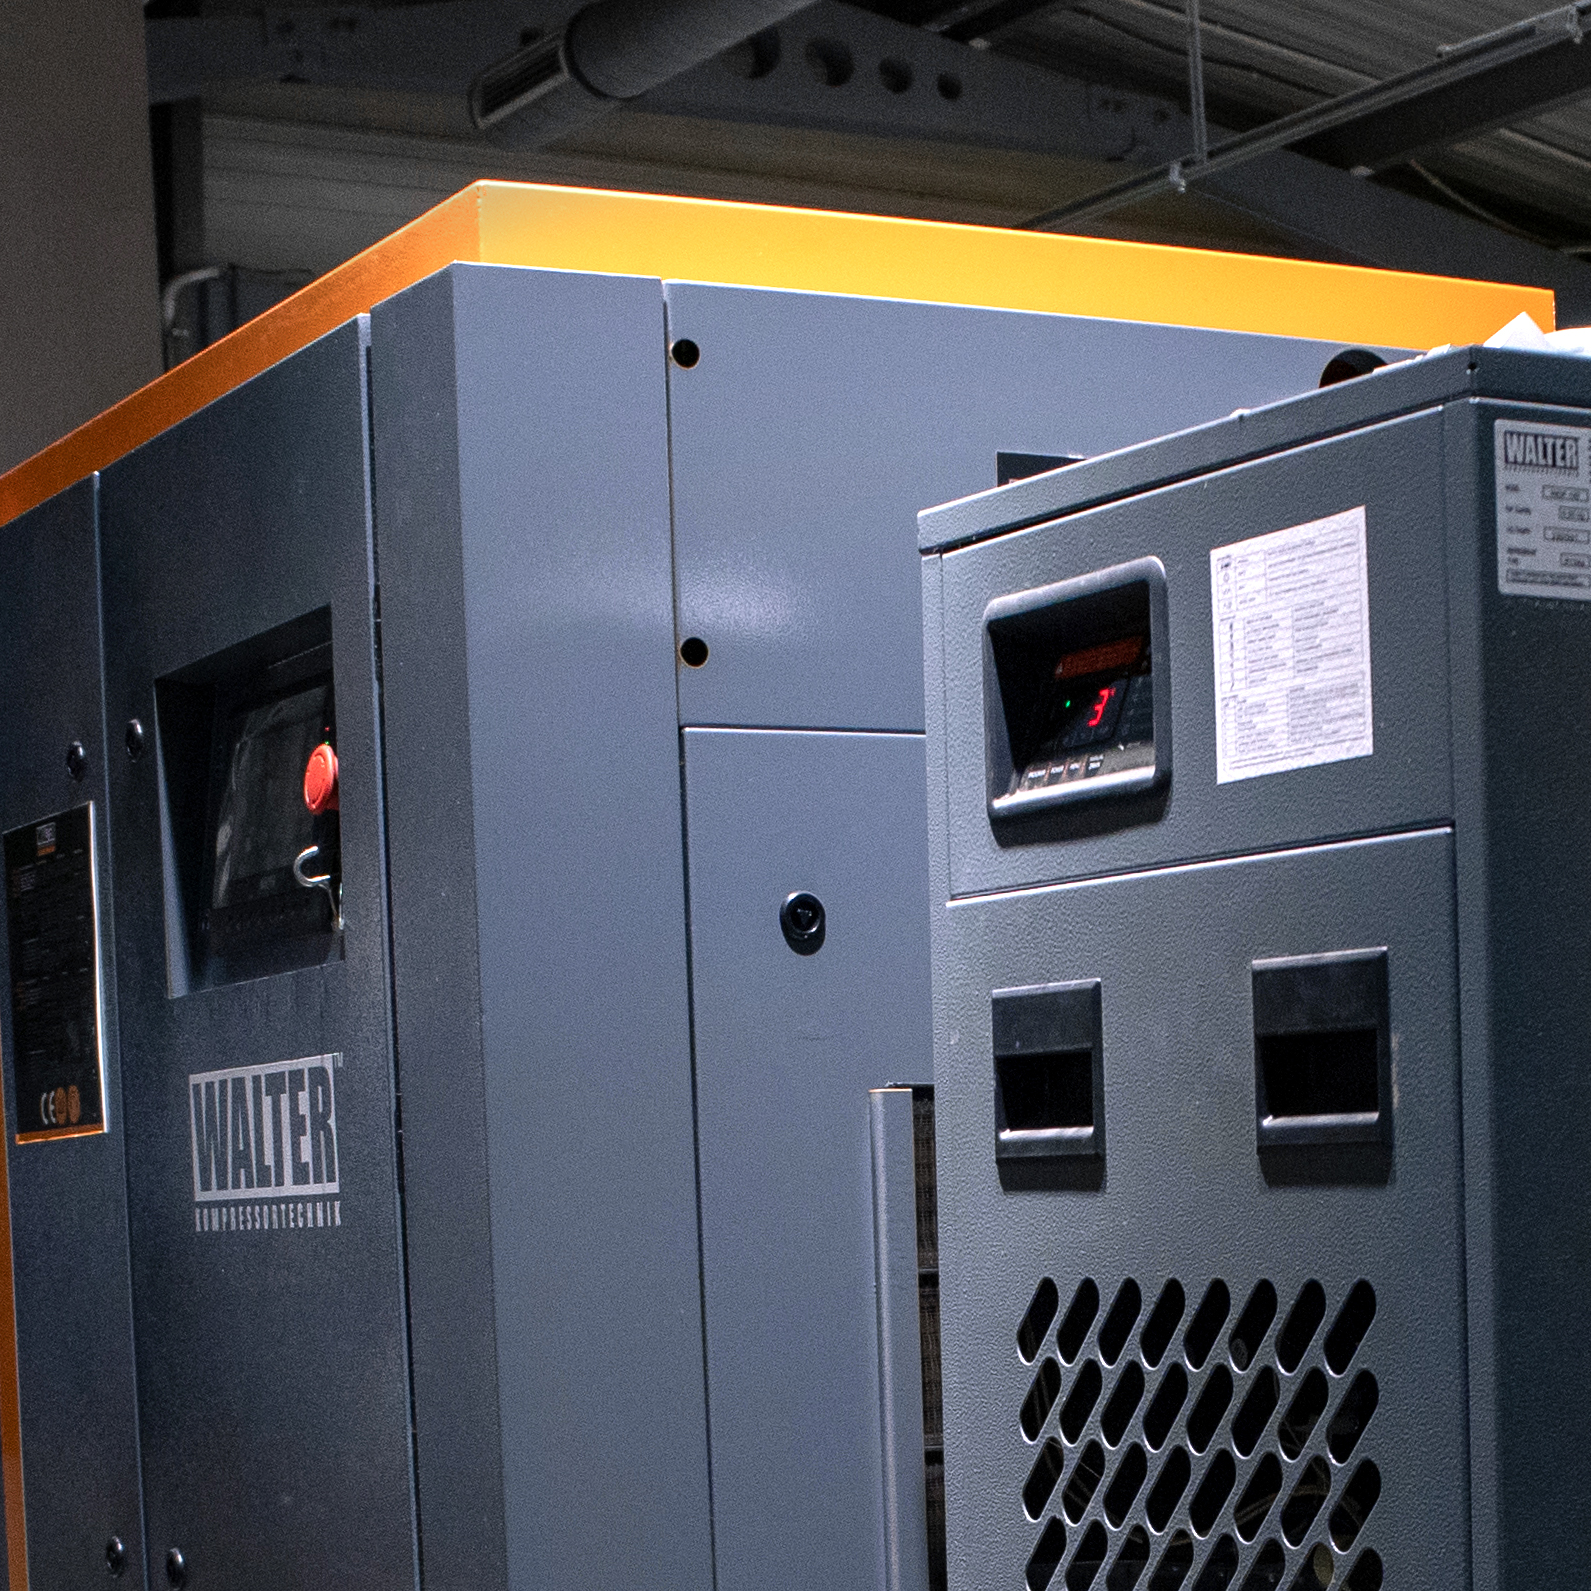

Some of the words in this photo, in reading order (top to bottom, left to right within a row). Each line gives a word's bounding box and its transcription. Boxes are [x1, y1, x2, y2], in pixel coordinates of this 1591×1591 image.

[1505, 432, 1579, 469] WALTER
[191, 1058, 339, 1196] WALTER
[195, 1201, 342, 1232] KOMPRESSORTECHNIK
